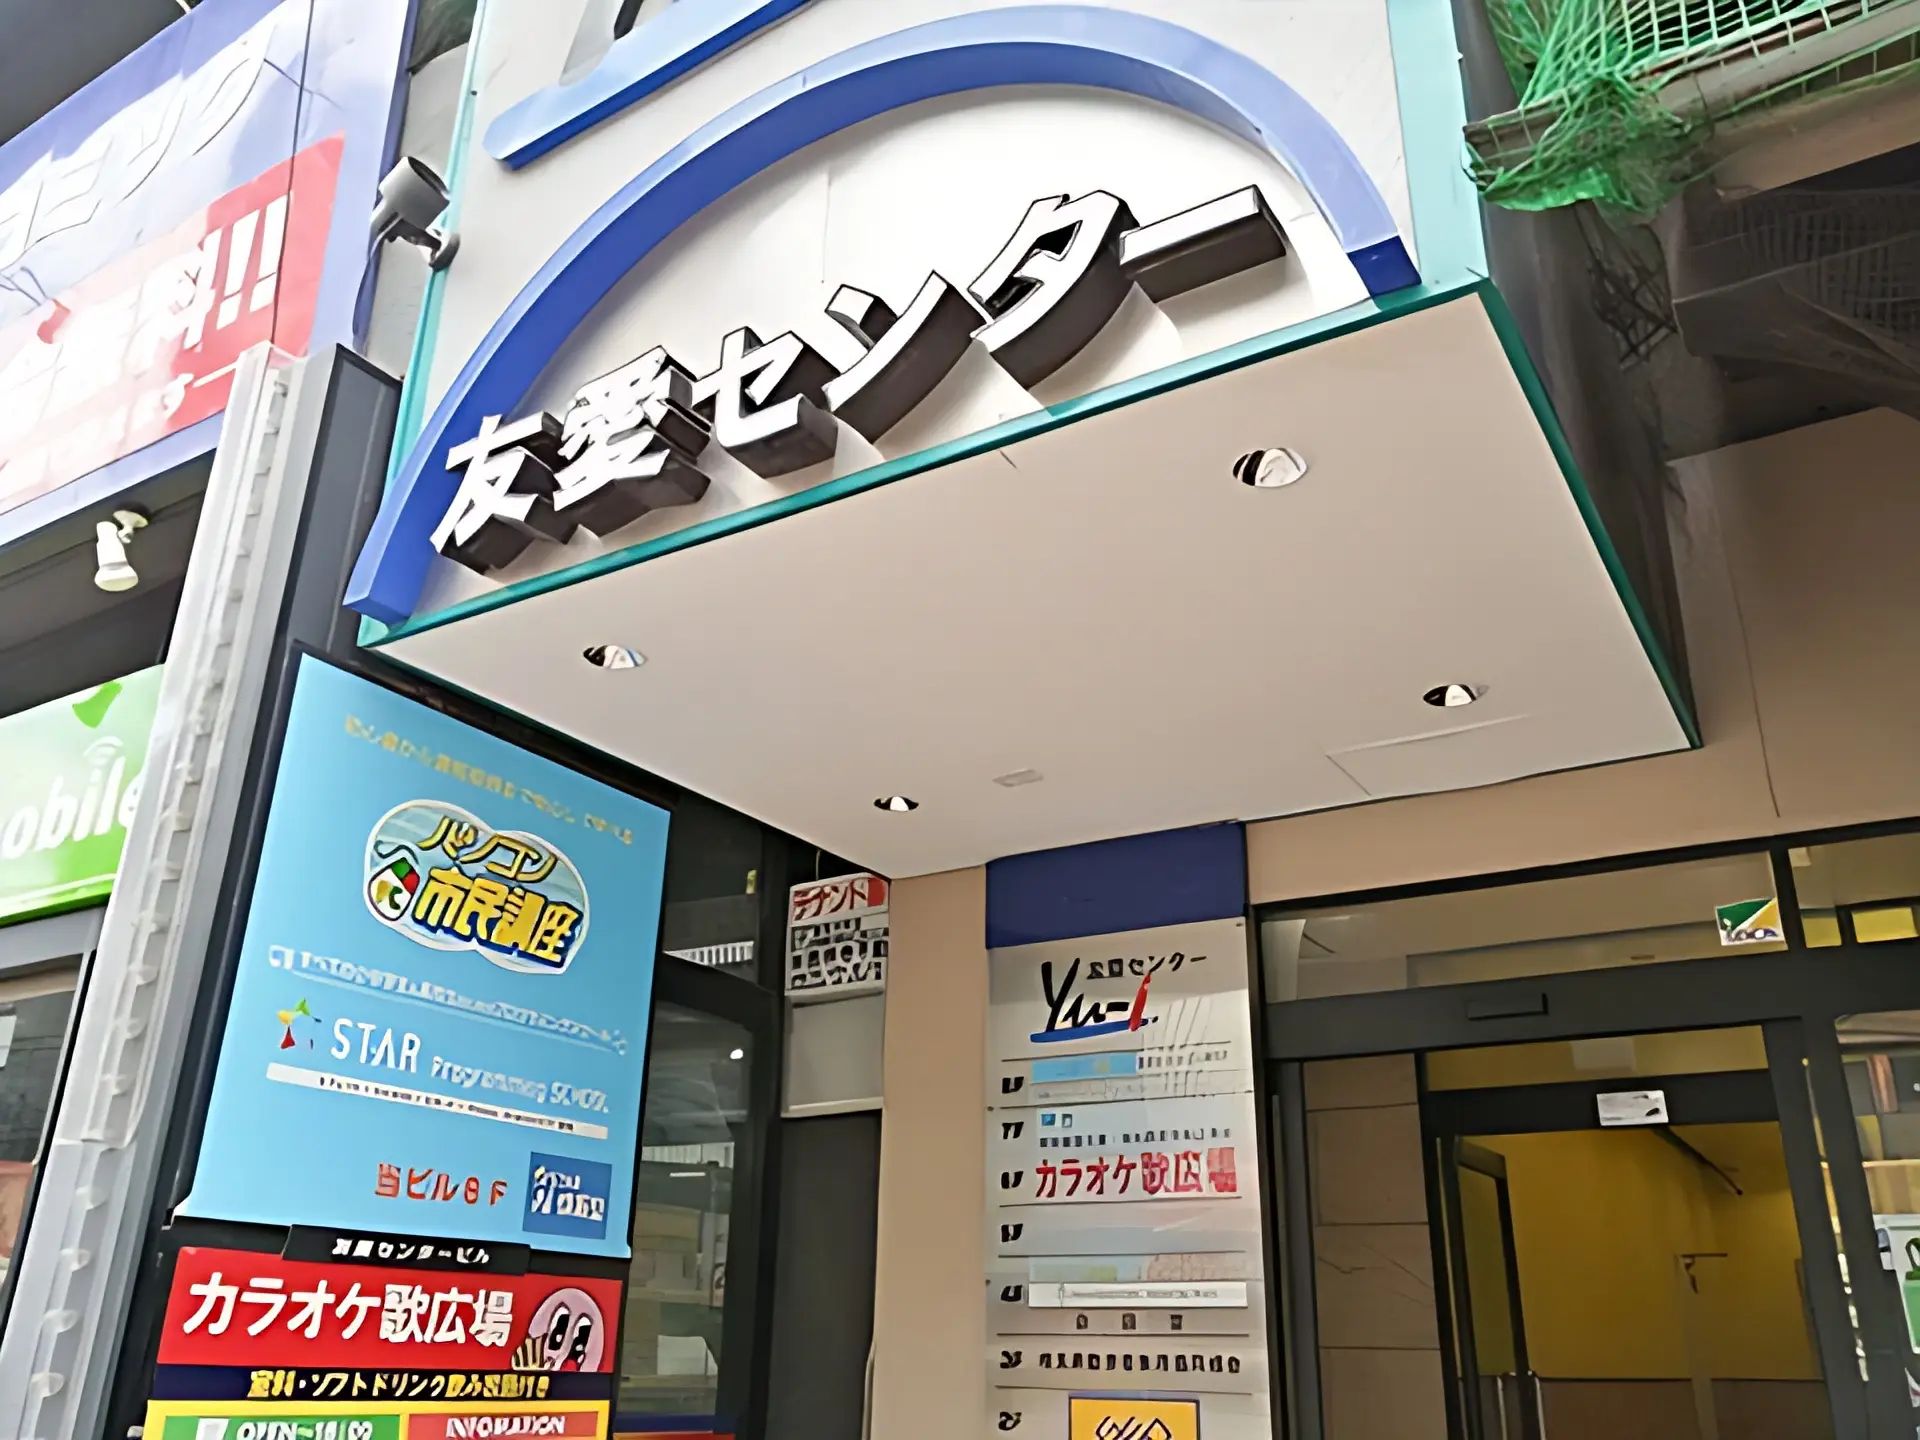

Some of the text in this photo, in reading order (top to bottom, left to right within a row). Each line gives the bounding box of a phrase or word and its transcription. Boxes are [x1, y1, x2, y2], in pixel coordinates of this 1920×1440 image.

[429, 184, 1287, 574] 友愛センター
[412, 865, 583, 968] 市民講座
[330, 1017, 421, 1074] STAR
[183, 1272, 513, 1347] カラオケ歌広場
